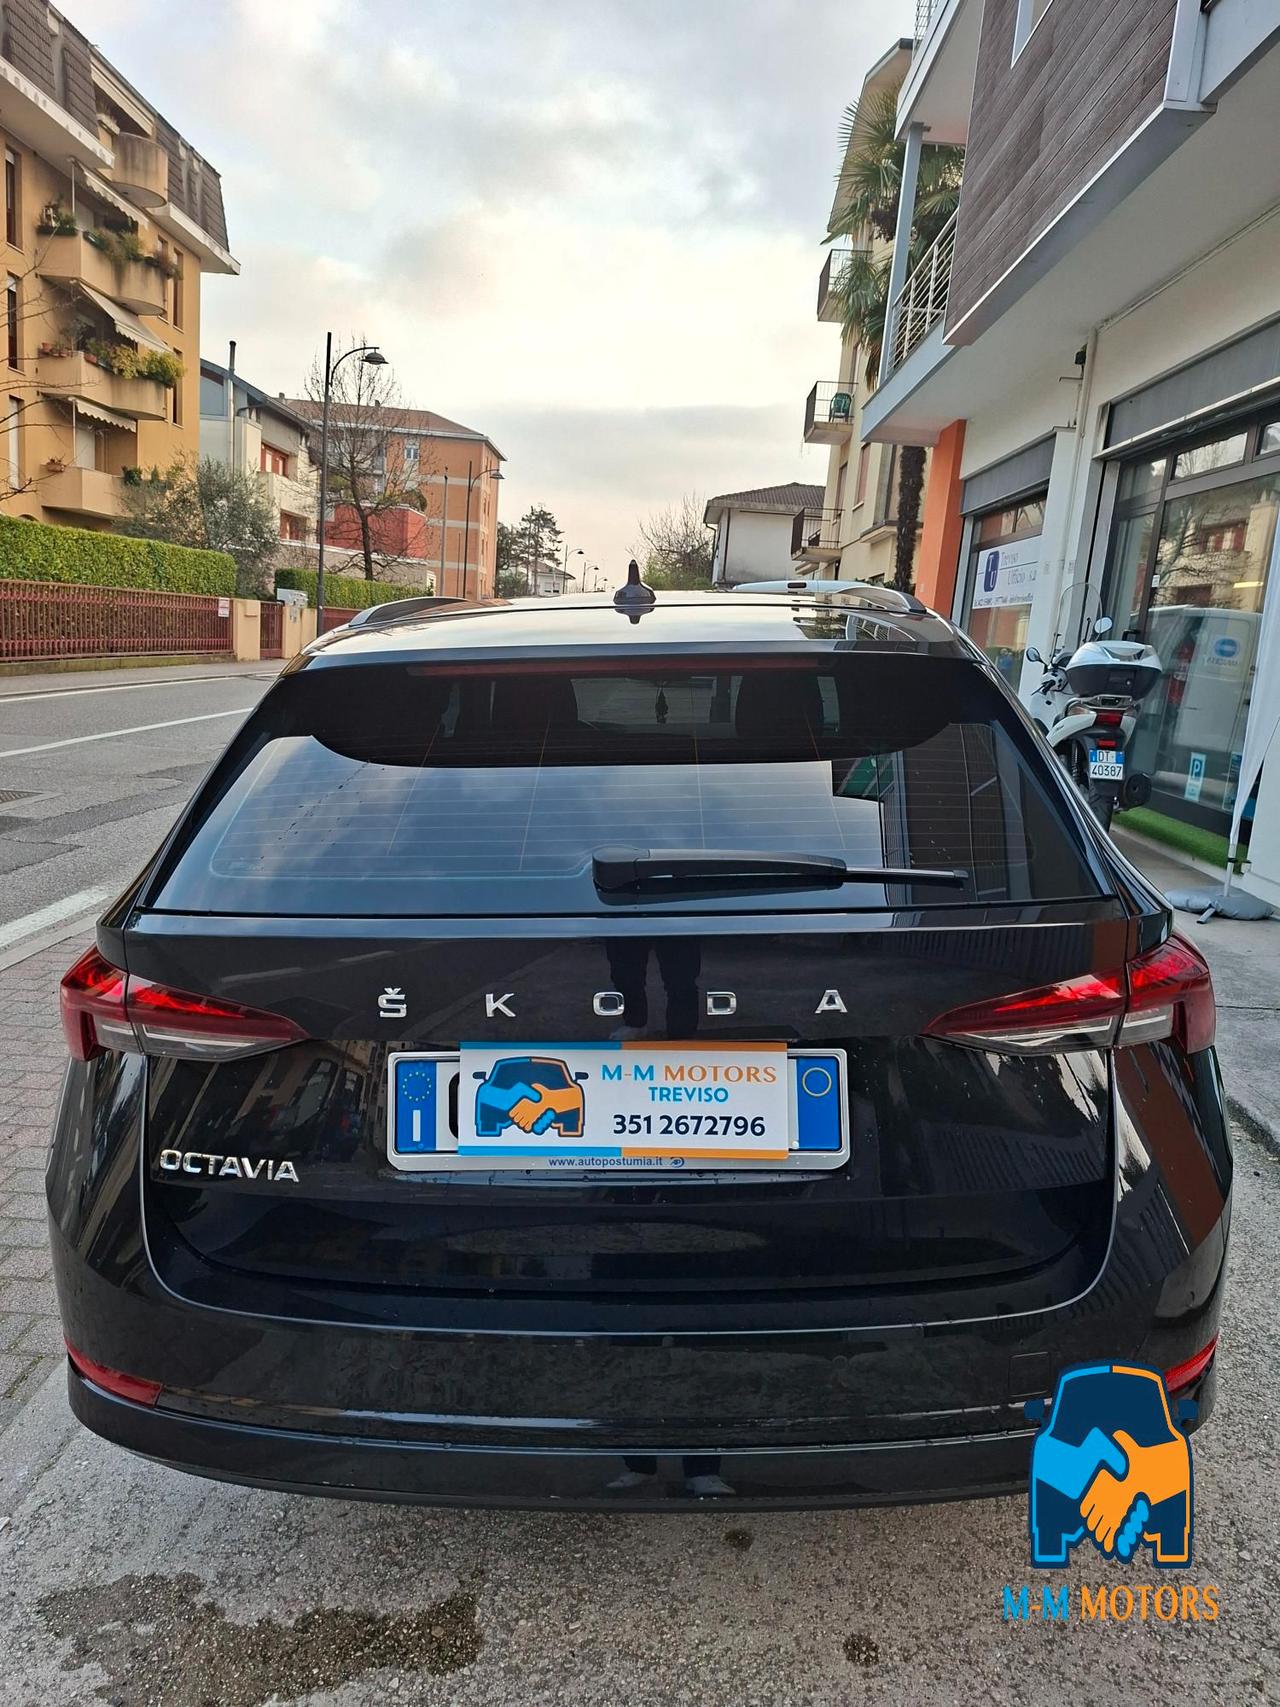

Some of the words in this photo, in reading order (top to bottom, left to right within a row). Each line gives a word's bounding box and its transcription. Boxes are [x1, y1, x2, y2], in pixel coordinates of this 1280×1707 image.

[1098, 751, 1111, 763] DT
[1091, 763, 1122, 778] 40387
[1192, 760, 1201, 779] P
[377, 986, 848, 1019] ŠKODA
[601, 1063, 654, 1082] M-M
[663, 1064, 777, 1084] MOTORS
[648, 1086, 729, 1104] TREVISO
[613, 1114, 653, 1135] 351
[659, 1114, 766, 1137] 2672796
[159, 1149, 300, 1183] OCTAVIA
[548, 1156, 663, 1169] www.autopostumia.it
